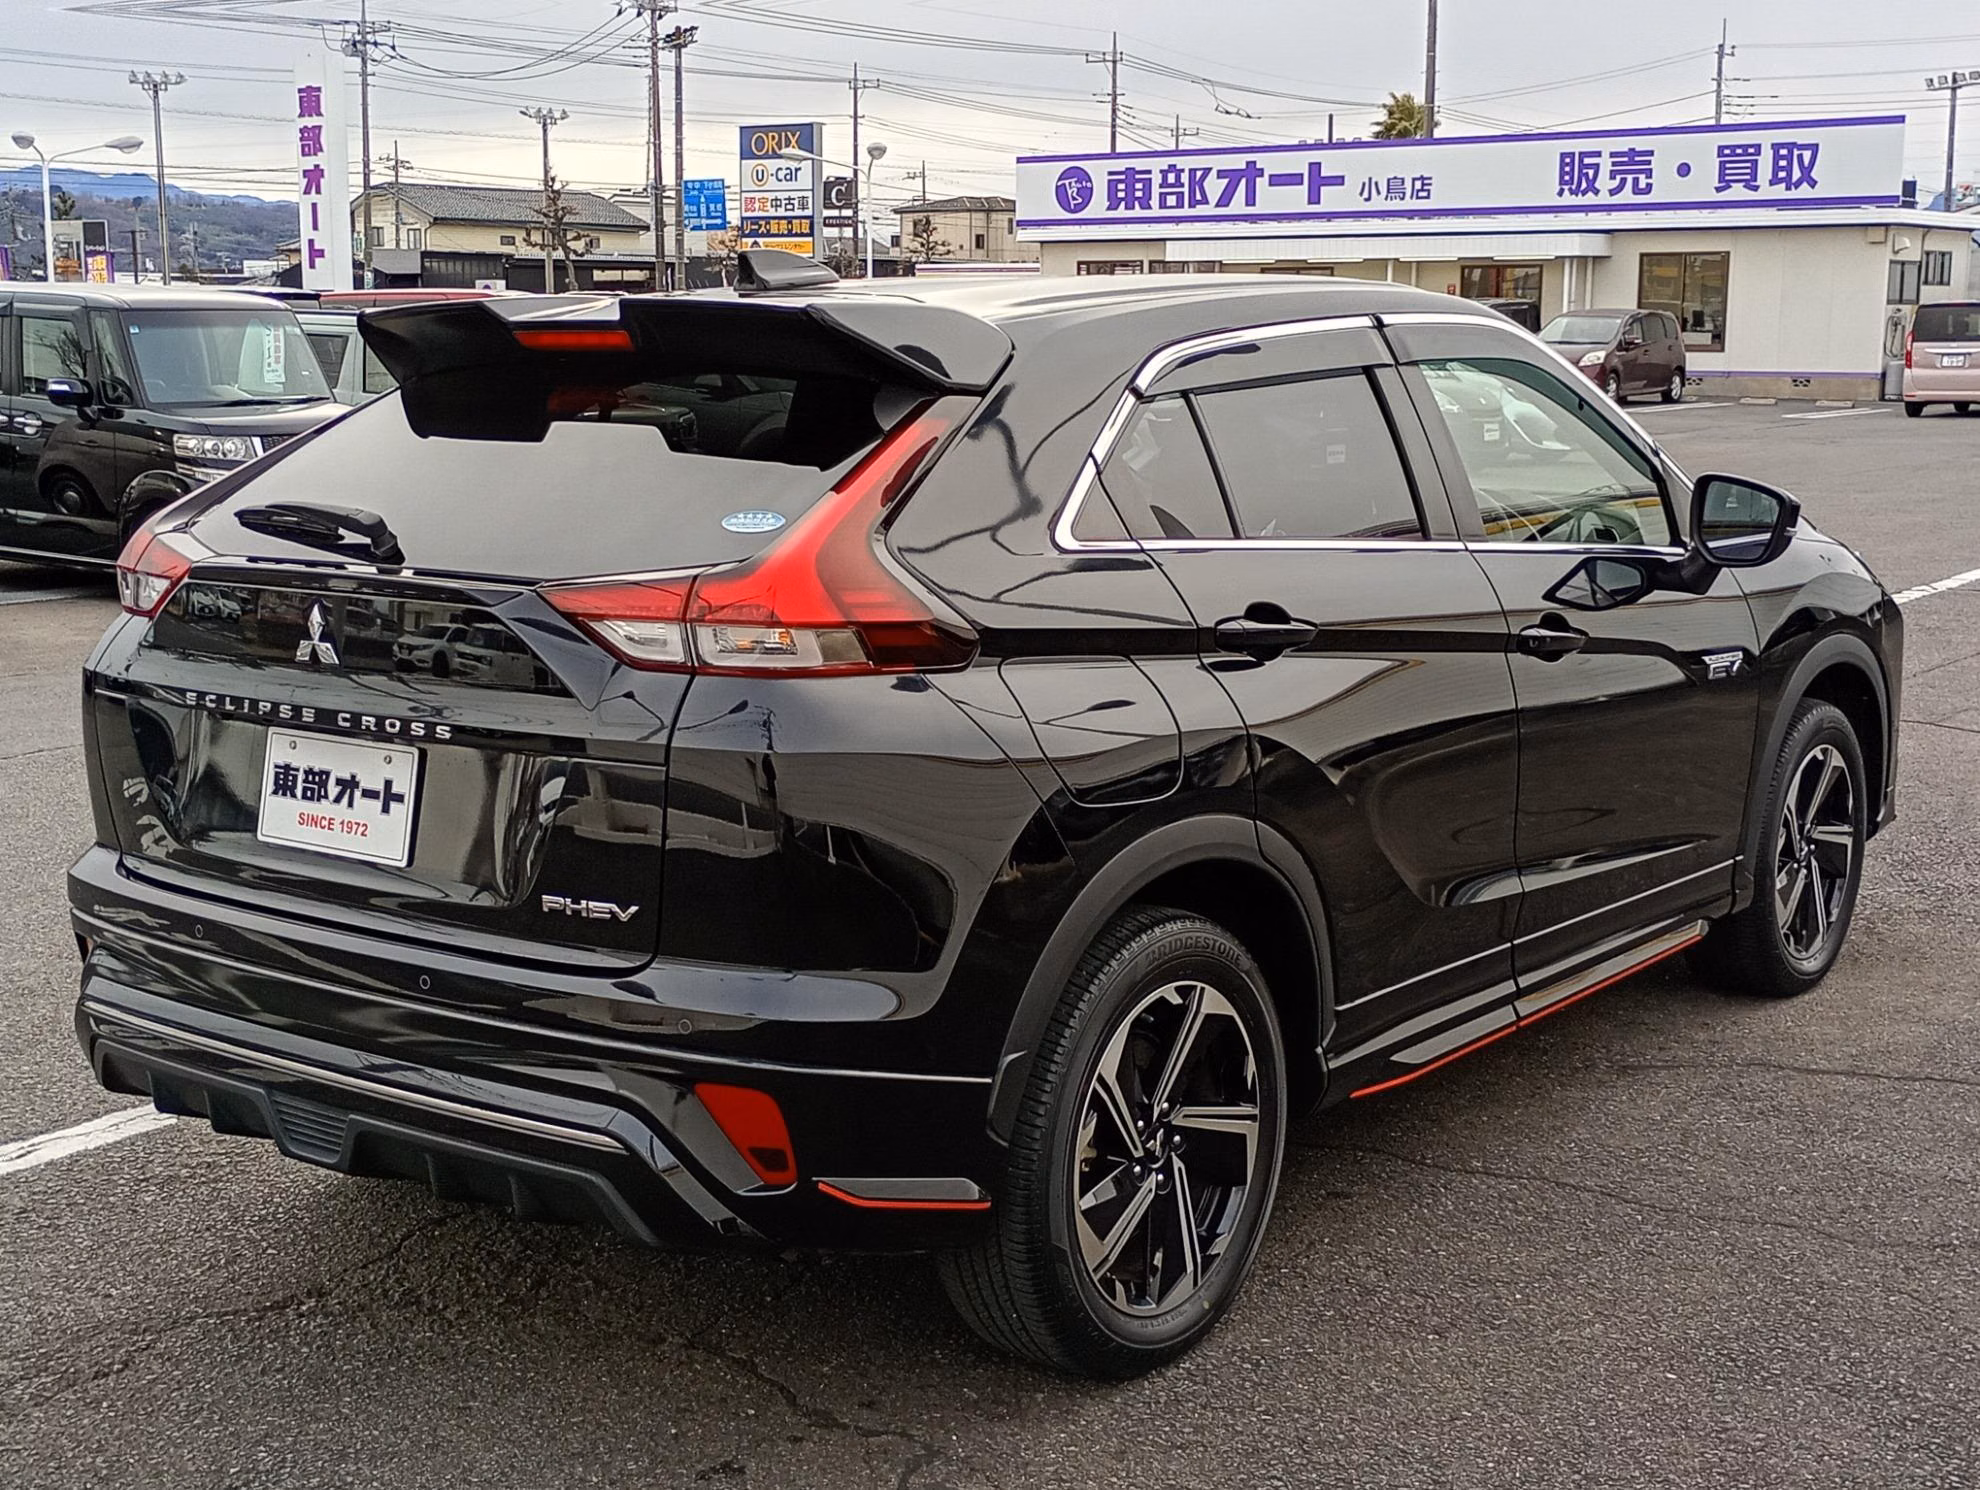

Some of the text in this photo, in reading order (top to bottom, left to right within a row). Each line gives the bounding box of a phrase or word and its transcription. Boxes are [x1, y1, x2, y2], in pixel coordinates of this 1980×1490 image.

[751, 131, 801, 155] ORIX
[297, 85, 326, 270] 東部オート
[1105, 160, 1346, 211] 東部オート
[1556, 141, 1820, 198] 販売・買取
[744, 196, 810, 213] 認定中古車
[185, 692, 453, 740] ECLIPSE CROSS
[270, 761, 406, 816] 東部オート
[297, 812, 369, 837] SINCE 1972
[541, 894, 640, 922] PHEV
[1148, 934, 1242, 964] BRIDGESTONE
